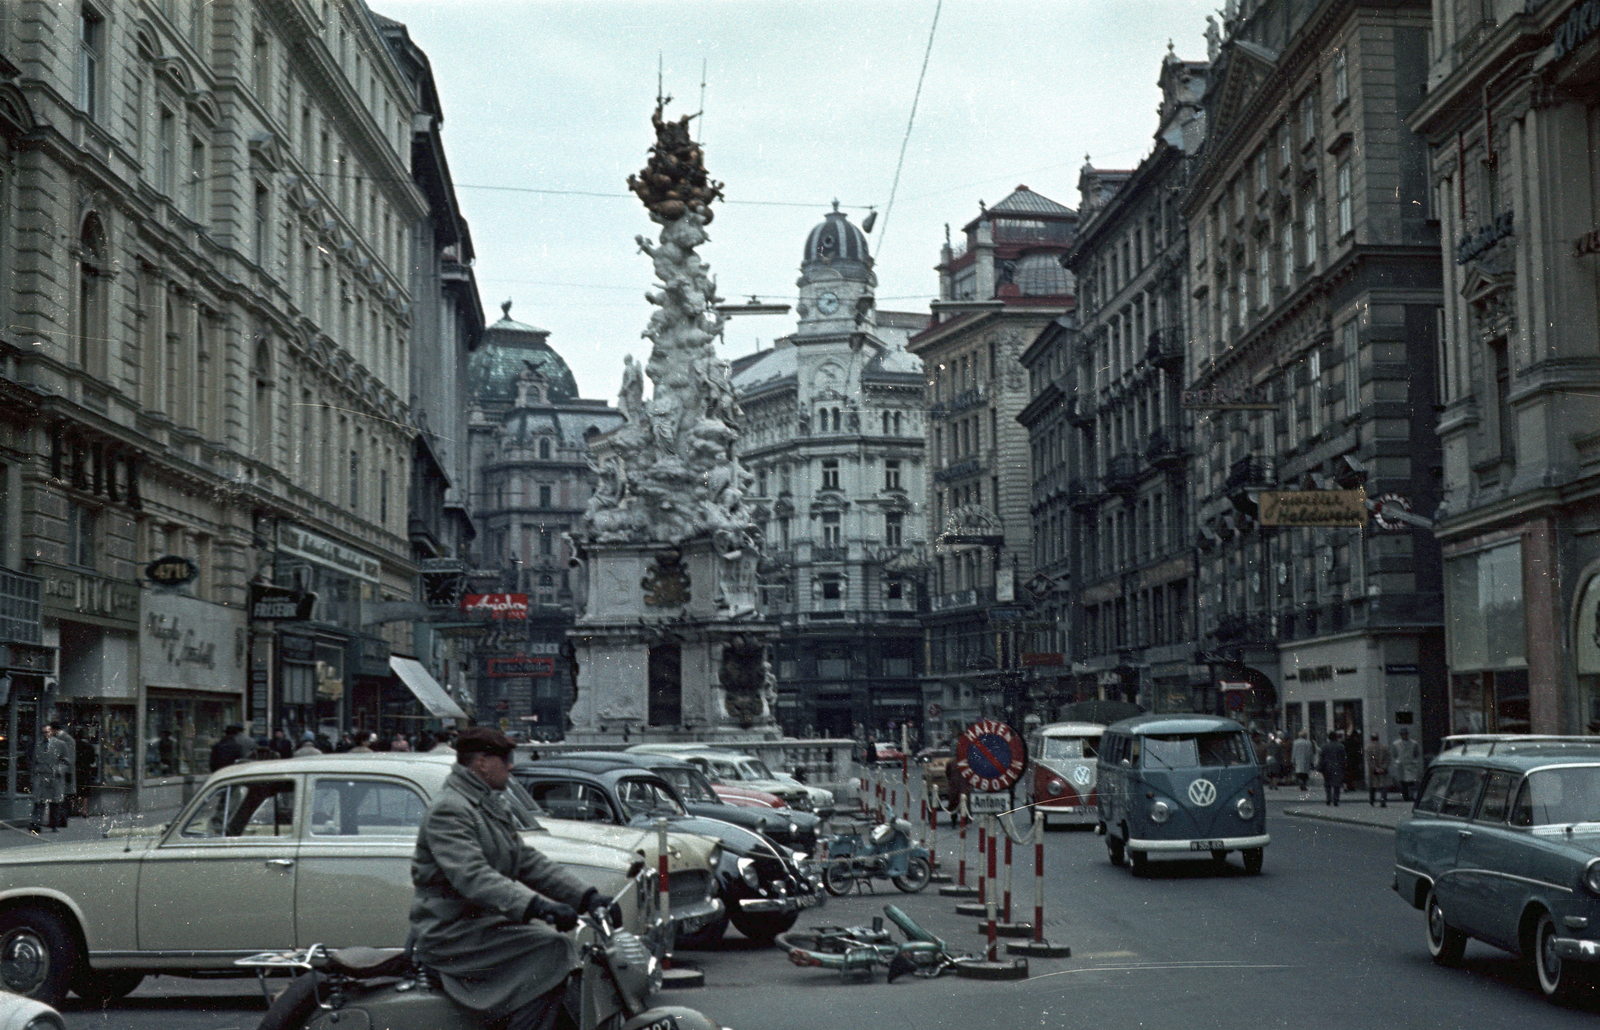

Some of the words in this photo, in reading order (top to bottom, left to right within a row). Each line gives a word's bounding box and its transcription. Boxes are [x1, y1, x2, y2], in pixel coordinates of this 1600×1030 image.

[154, 563, 187, 579] 4711
[964, 719, 1012, 742] HALTEN
[957, 759, 1023, 791] VERBOTEN
[973, 796, 1006, 812] Anfang
[1188, 778, 1217, 807] VW
